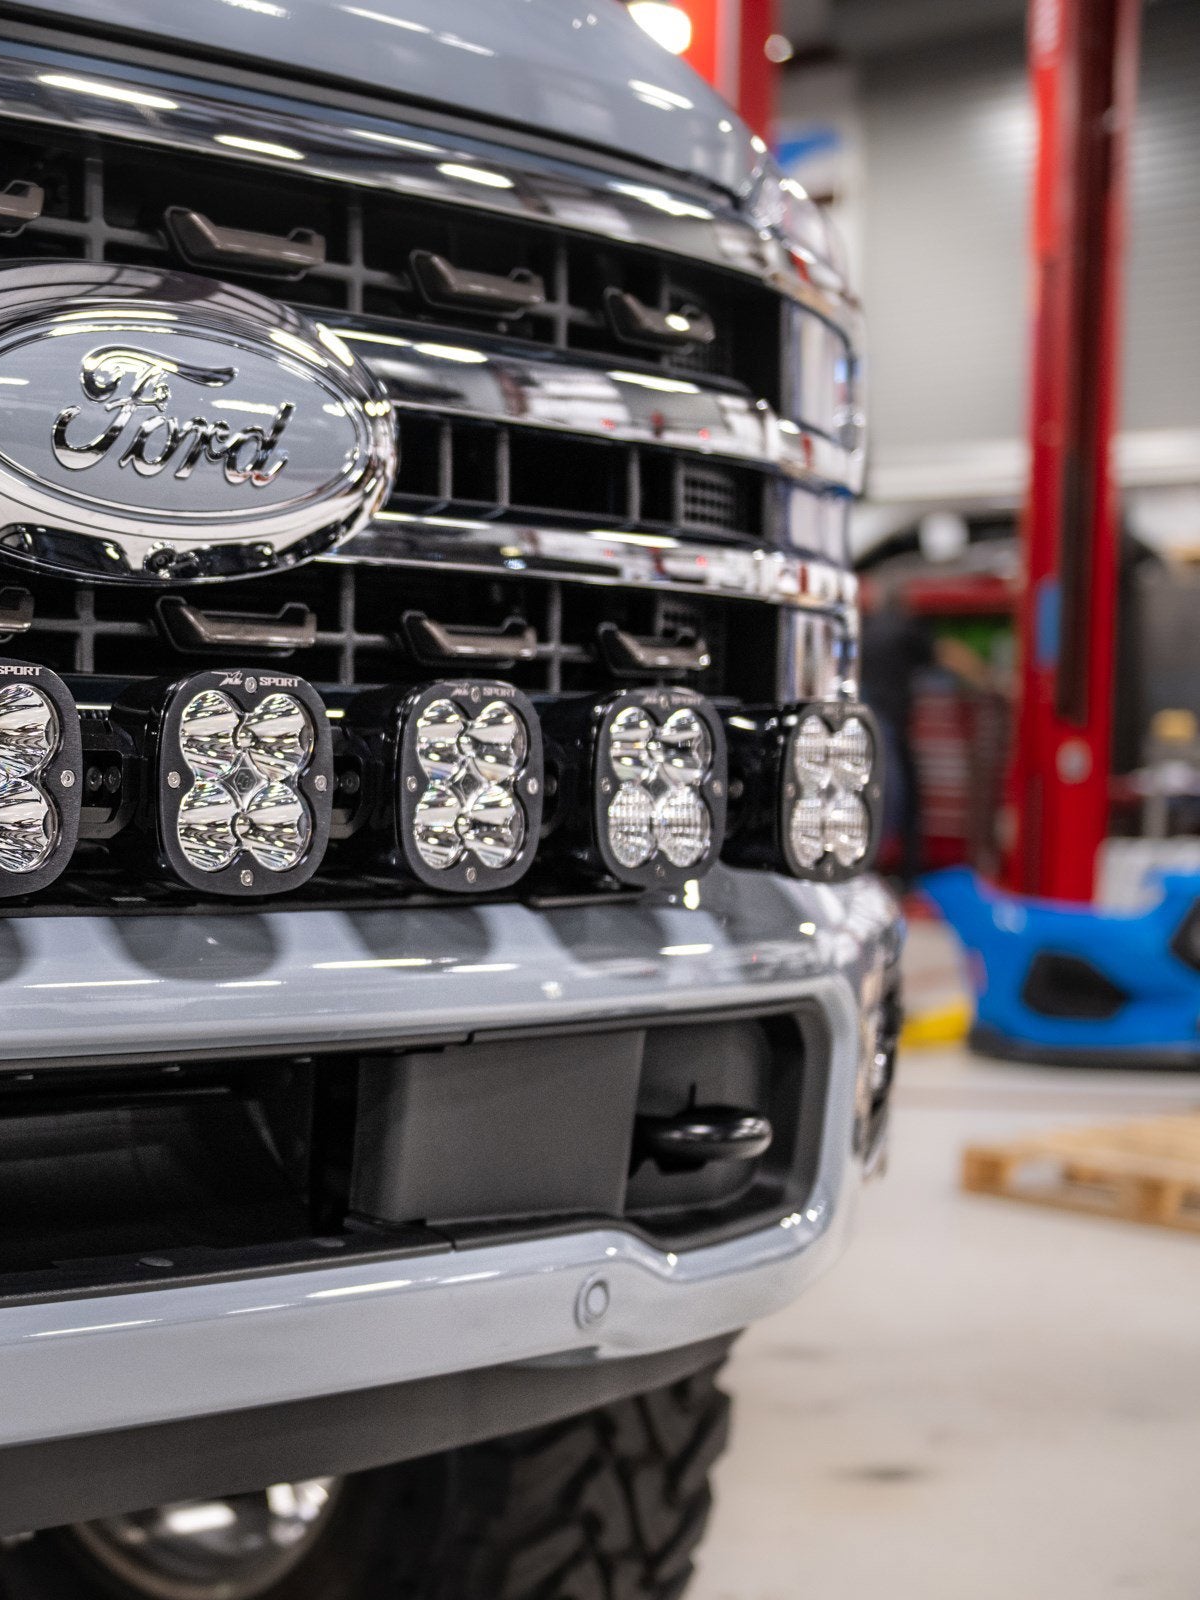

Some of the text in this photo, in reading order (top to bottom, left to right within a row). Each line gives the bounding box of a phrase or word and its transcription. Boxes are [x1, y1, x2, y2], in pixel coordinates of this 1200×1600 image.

[52, 343, 297, 487] Ford
[259, 677, 299, 687] SPORT
[483, 687, 516, 697] SPORT
